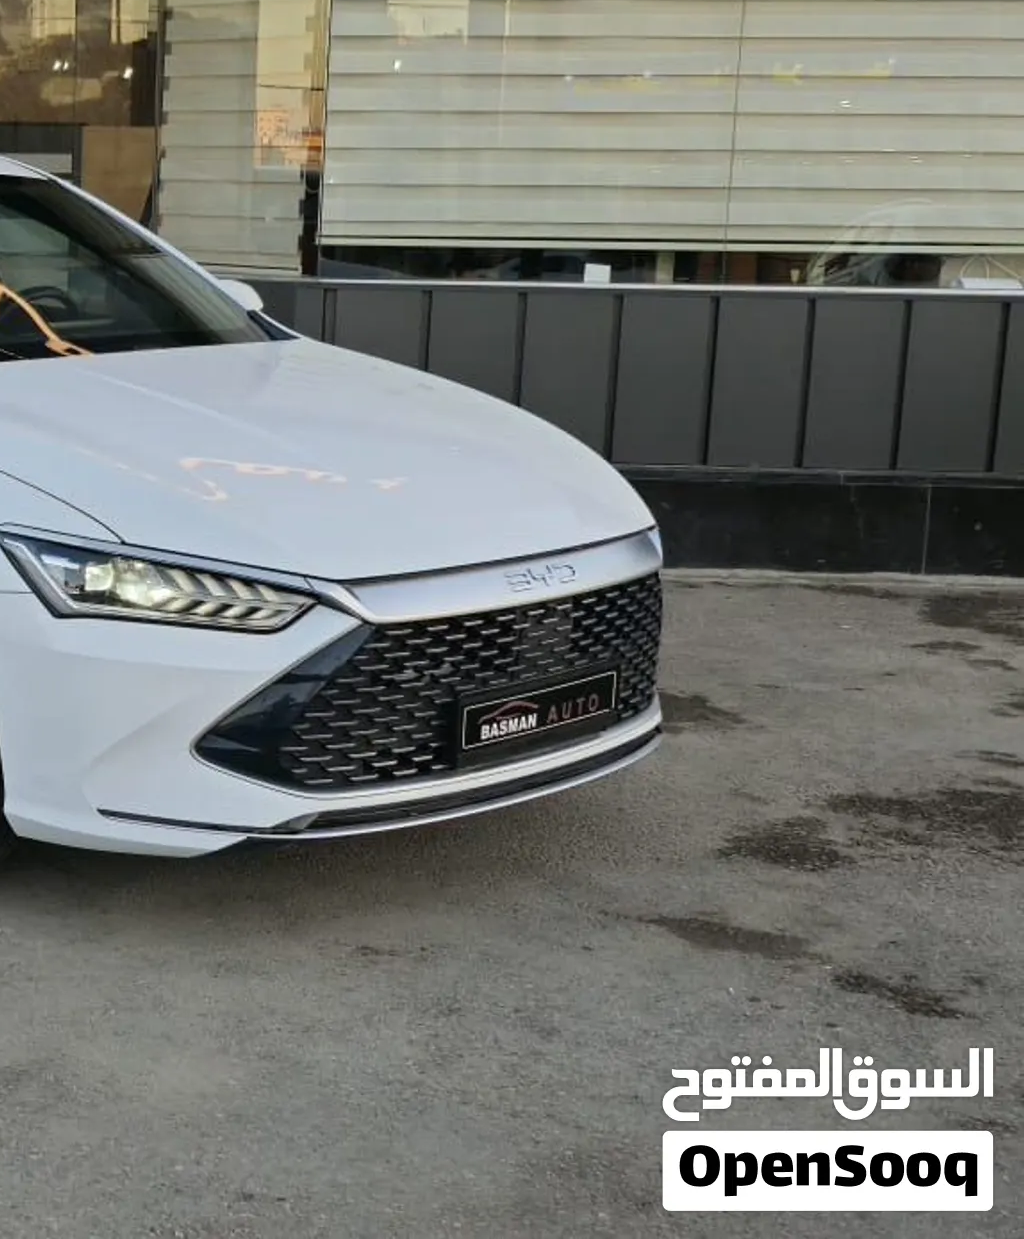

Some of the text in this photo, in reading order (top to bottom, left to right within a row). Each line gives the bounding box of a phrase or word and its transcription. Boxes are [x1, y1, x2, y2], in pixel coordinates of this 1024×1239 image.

[505, 564, 576, 593] BYD
[480, 693, 600, 740] BASMAN AUTO
